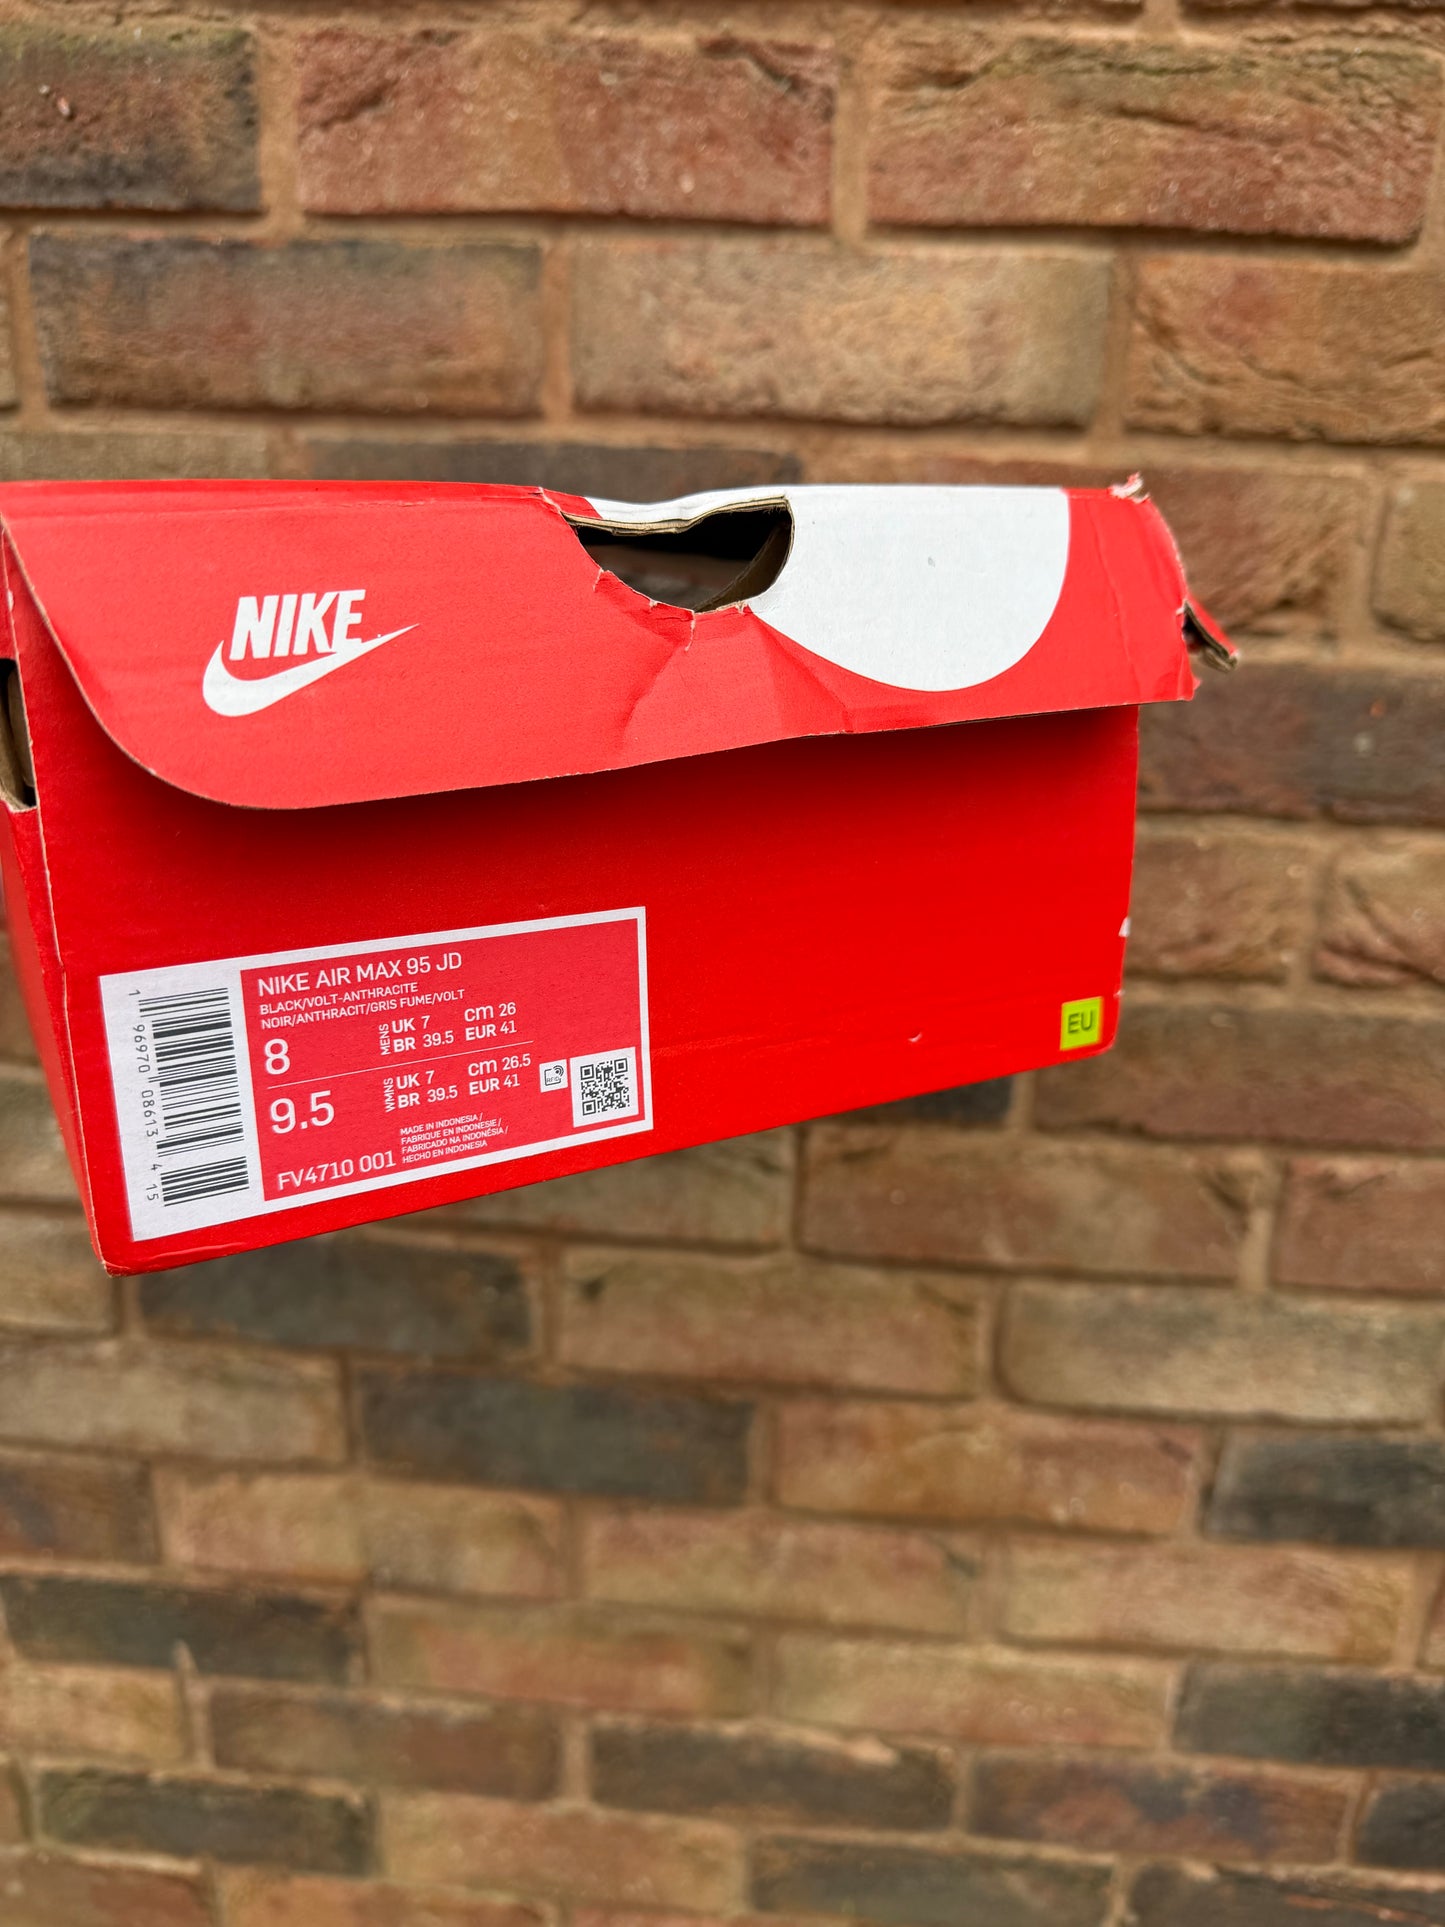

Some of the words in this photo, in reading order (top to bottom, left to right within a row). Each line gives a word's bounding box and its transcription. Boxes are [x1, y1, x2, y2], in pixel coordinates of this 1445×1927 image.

[229, 589, 366, 661] NIKE
[257, 972, 310, 997] NIKE
[315, 967, 351, 989] AIR
[356, 959, 403, 983] MAX
[406, 956, 431, 975] 95
[436, 952, 463, 972] JD
[128, 989, 141, 997] 1
[259, 982, 418, 1016] BLACK/VOLT-ANTHRACITE
[261, 1000, 397, 1030] NOIR/ANTHRACIT/GRIS
[400, 989, 465, 1008] FUME/VOLT
[464, 1004, 494, 1023] cm
[498, 1002, 517, 1018] 26
[391, 1018, 416, 1034] UK
[421, 1015, 431, 1030] 7
[465, 1024, 497, 1041] EUR
[500, 1020, 517, 1035] 41
[1067, 1010, 1093, 1034] EU
[132, 1024, 151, 1074] 96970
[378, 1023, 391, 1056] MENS
[393, 1037, 417, 1053] BR
[422, 1030, 455, 1048] 39.5
[264, 1038, 291, 1075] 8
[468, 1059, 498, 1077] cm
[502, 1053, 531, 1071] 26.5
[396, 1073, 421, 1090] UK
[425, 1070, 435, 1085] 7
[469, 1078, 500, 1096] EUR
[503, 1074, 520, 1088] 41
[383, 1077, 396, 1113] WMNS
[398, 1092, 421, 1109] BR
[427, 1085, 458, 1103] 39.5
[141, 1089, 159, 1138] 08613
[270, 1090, 335, 1134] 9.5
[400, 1124, 424, 1135] MADE
[426, 1122, 434, 1130] IN
[436, 1114, 478, 1129] INDONESIA
[400, 1131, 441, 1145] FABRIQUE
[443, 1128, 454, 1137] EN
[402, 1138, 448, 1154] FABRICADO
[449, 1136, 461, 1144] NA
[402, 1151, 431, 1163] HECHO
[433, 1149, 444, 1157] EN
[445, 1140, 488, 1156] INDONESIA
[150, 1163, 163, 1171] 4
[277, 1159, 354, 1191] FV4710
[359, 1150, 396, 1173] 001
[145, 1183, 160, 1201] 15
